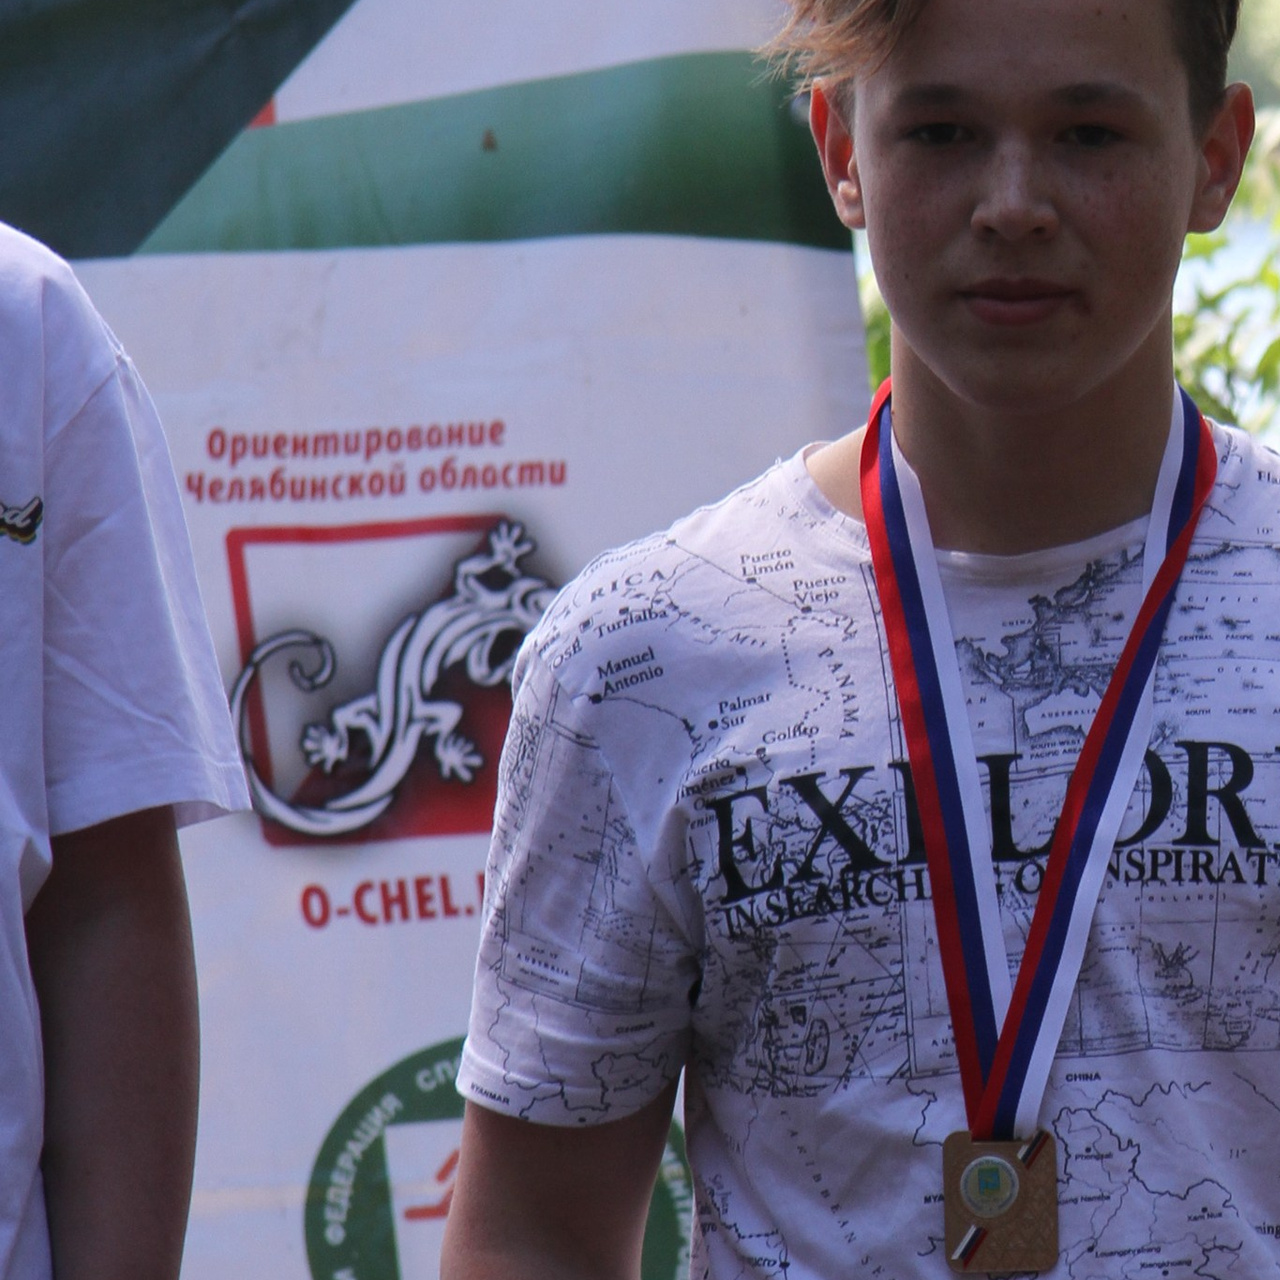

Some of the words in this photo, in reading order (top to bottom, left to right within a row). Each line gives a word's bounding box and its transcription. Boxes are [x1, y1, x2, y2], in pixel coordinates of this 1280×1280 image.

[207, 419, 507, 468] Ориентирование
[186, 464, 407, 505] Челябинской
[418, 457, 568, 490] области
[740, 548, 791, 565] Puerto
[742, 561, 794, 578] Limón
[590, 569, 667, 602] RICA
[793, 575, 846, 592] Puerto
[795, 589, 839, 605] Viejo
[597, 646, 656, 680] Manuel
[603, 665, 665, 699] Antonio
[719, 691, 772, 715] Palmar
[818, 647, 860, 742] PANAMA
[721, 713, 747, 730] Sur
[1066, 1072, 1102, 1083] CHINA
[923, 1194, 945, 1204] MYA
